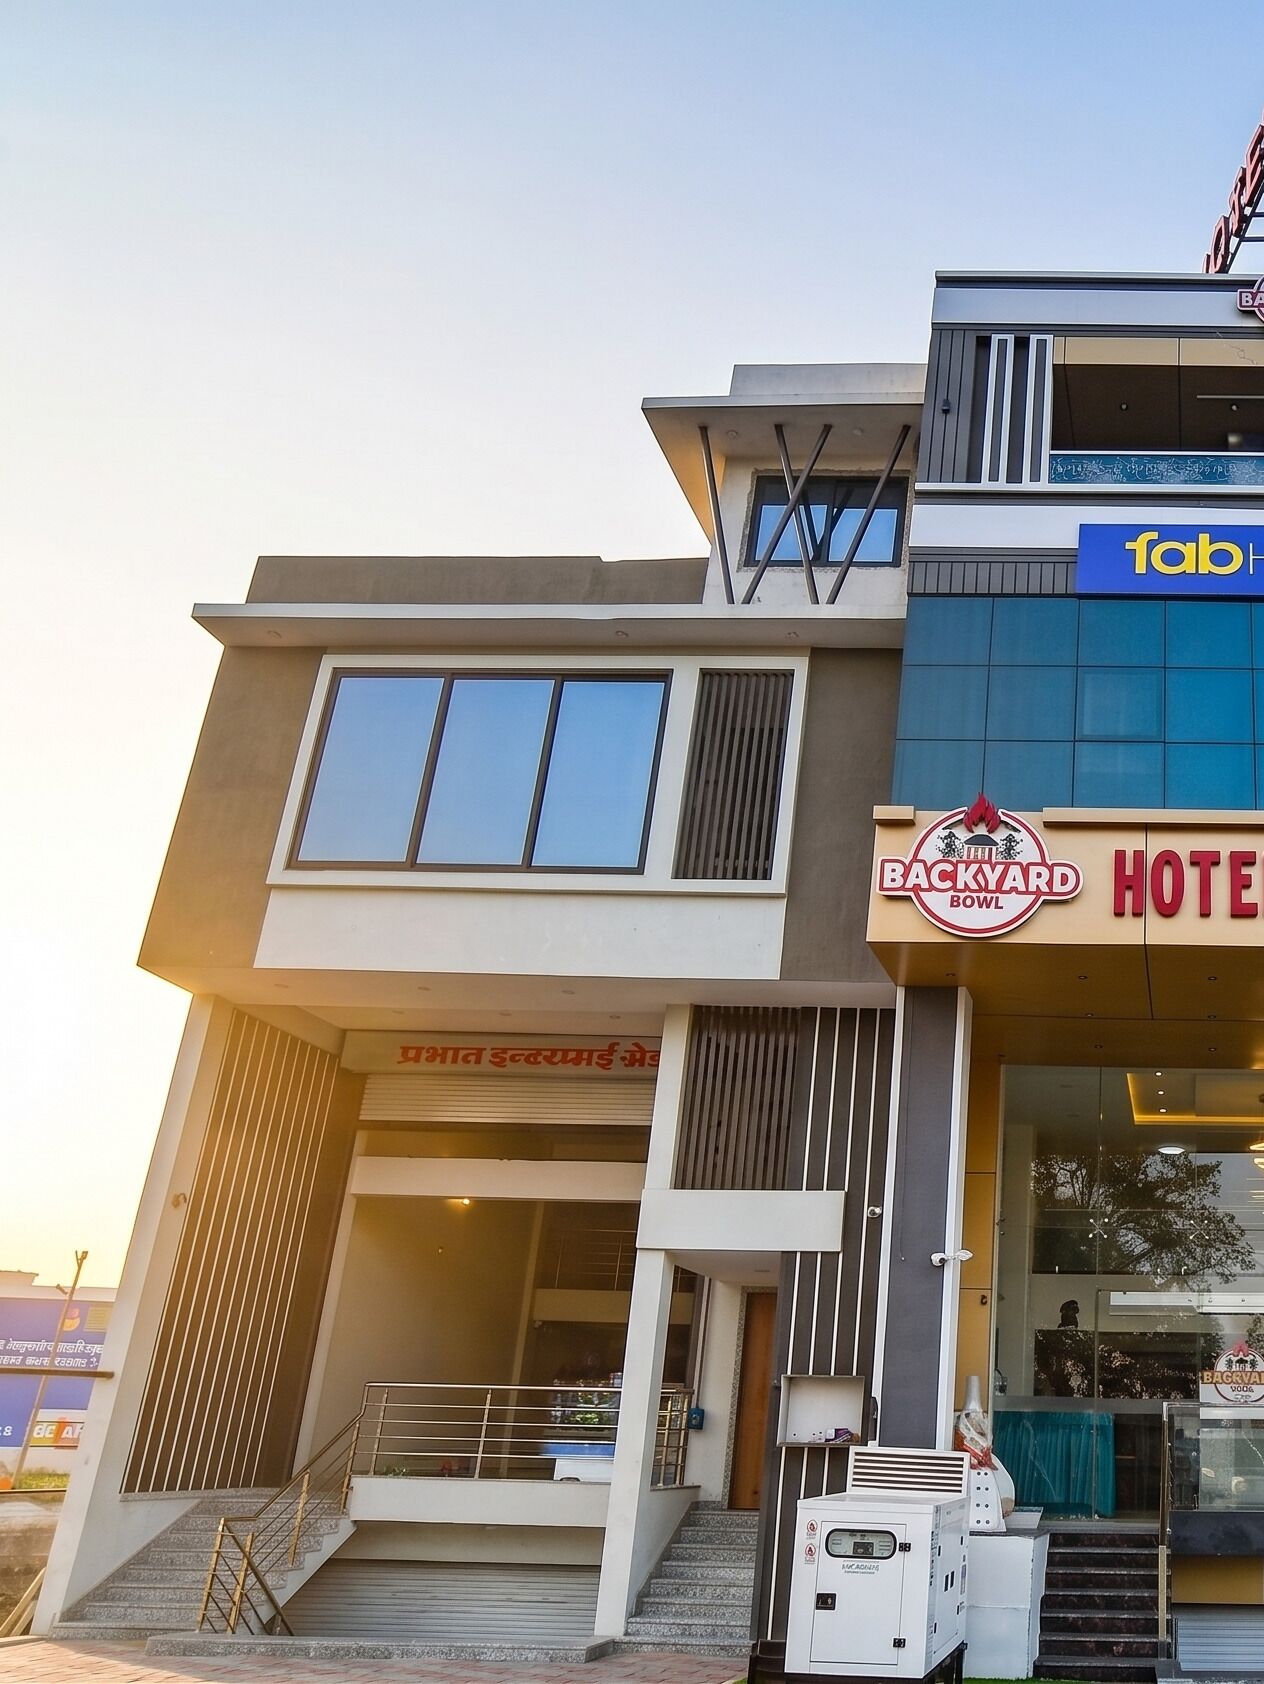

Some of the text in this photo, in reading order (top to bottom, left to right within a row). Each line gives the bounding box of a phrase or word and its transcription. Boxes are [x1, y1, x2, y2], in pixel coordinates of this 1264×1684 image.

[881, 861, 1077, 893] BACKYARD
[949, 894, 1004, 910] BOWL
[397, 1045, 487, 1065] प्रभात
